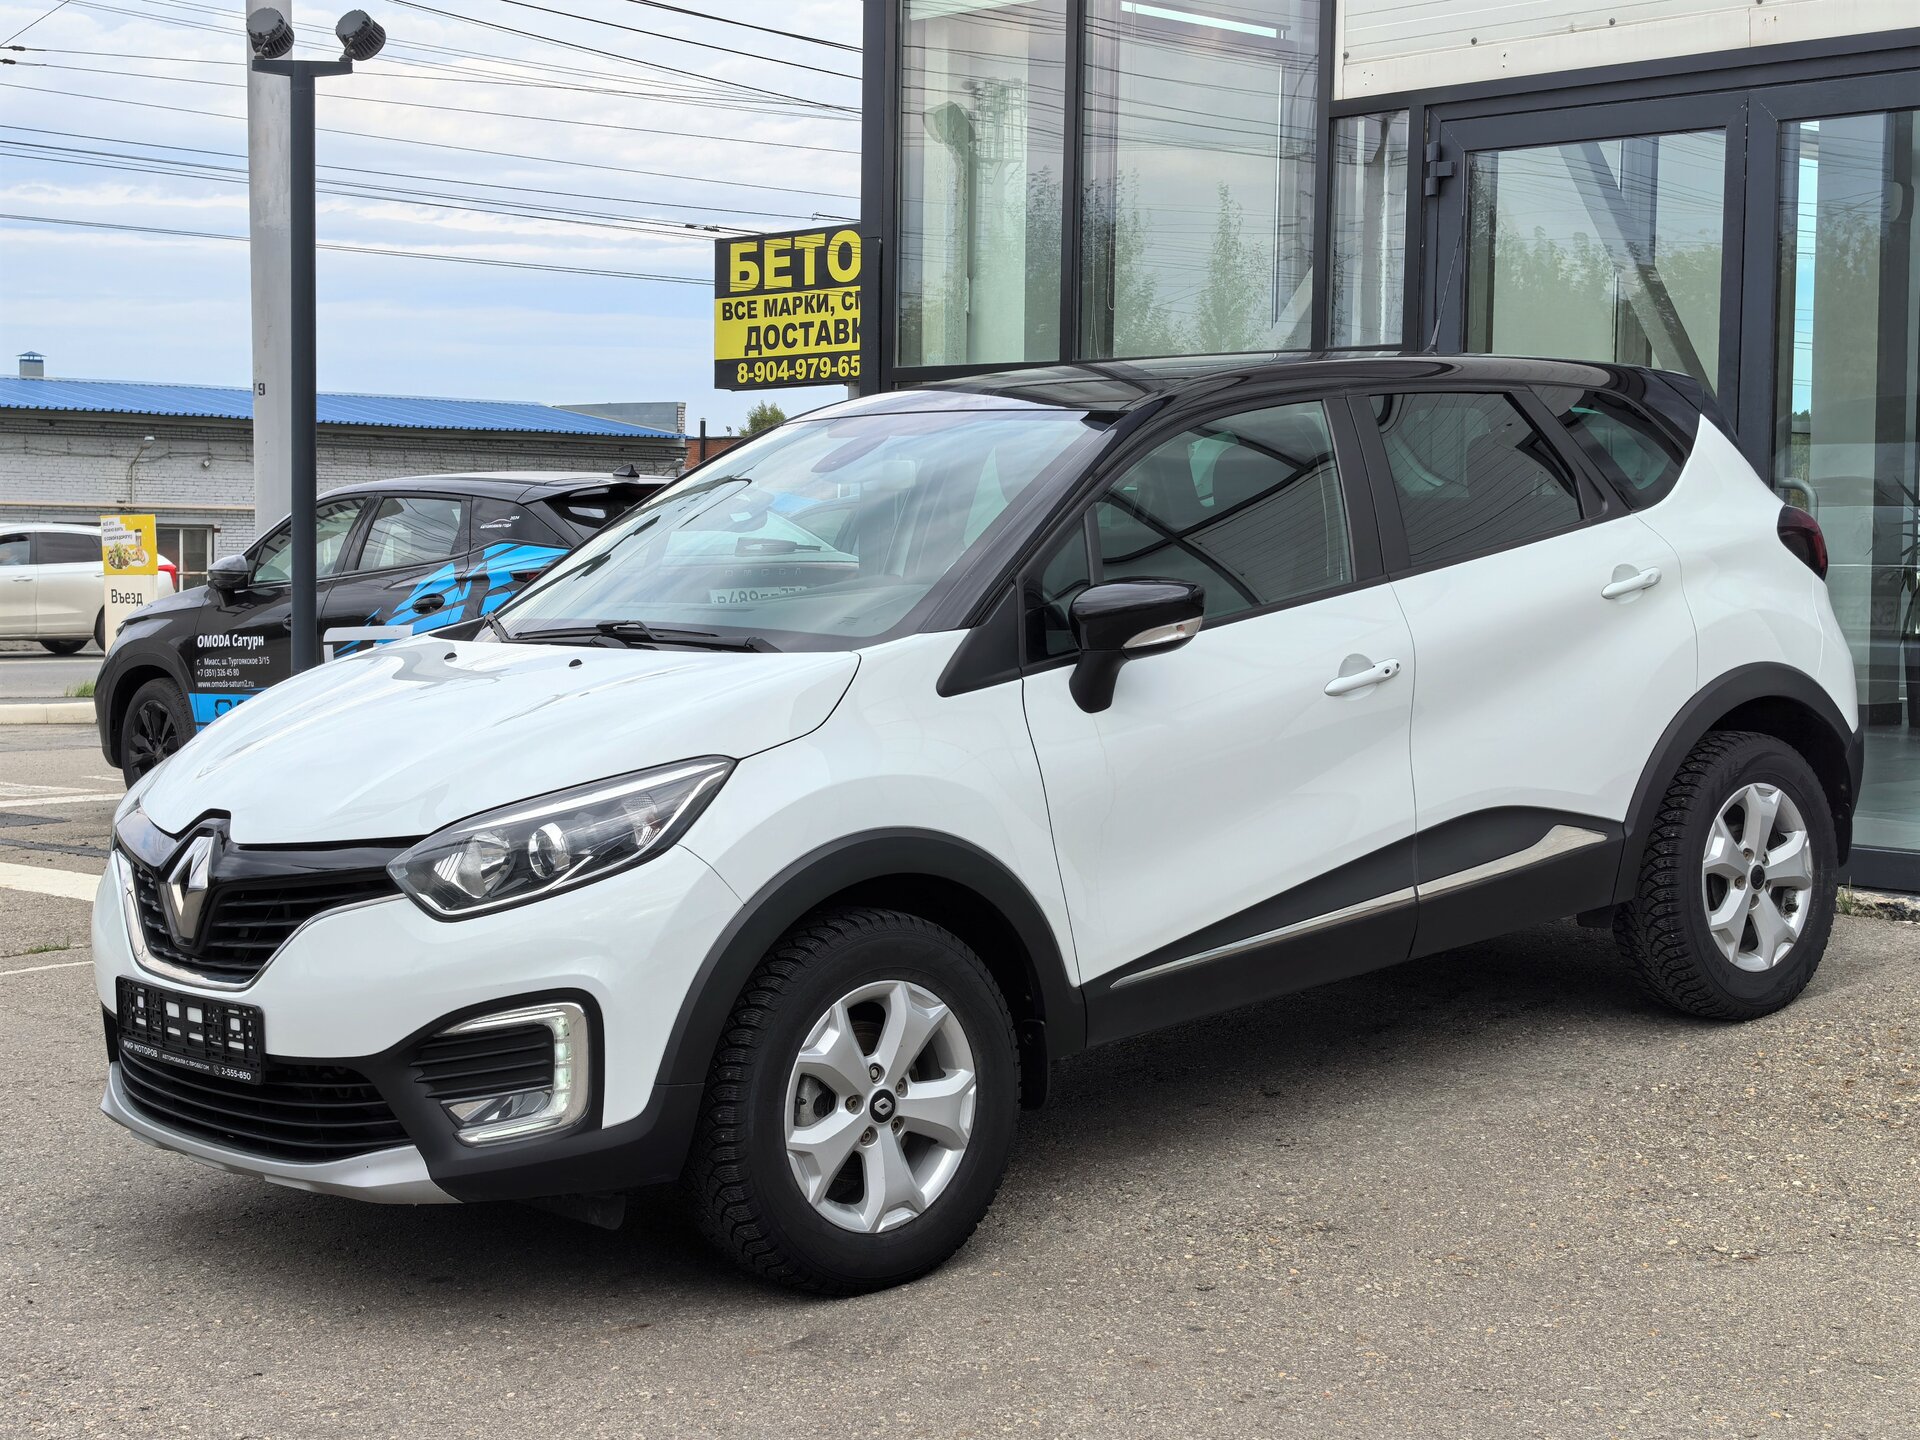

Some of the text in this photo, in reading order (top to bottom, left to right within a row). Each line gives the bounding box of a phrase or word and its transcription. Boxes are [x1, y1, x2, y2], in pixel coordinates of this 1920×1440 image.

[730, 229, 861, 293] БЕТО
[722, 300, 757, 321] ВСЕ
[764, 293, 835, 317] МАРКИ,
[737, 356, 861, 383] 8-904-979-65
[111, 588, 143, 606] Въезд
[197, 633, 264, 650] OMODA Сатурн
[258, 656, 270, 665] 3/15
[197, 669, 204, 677] +7
[204, 668, 217, 678] (351)
[217, 668, 227, 677] 326
[123, 1039, 134, 1050] МИР
[134, 1042, 158, 1058] МОТОРОВ
[221, 1067, 252, 1081] 2-555-850
